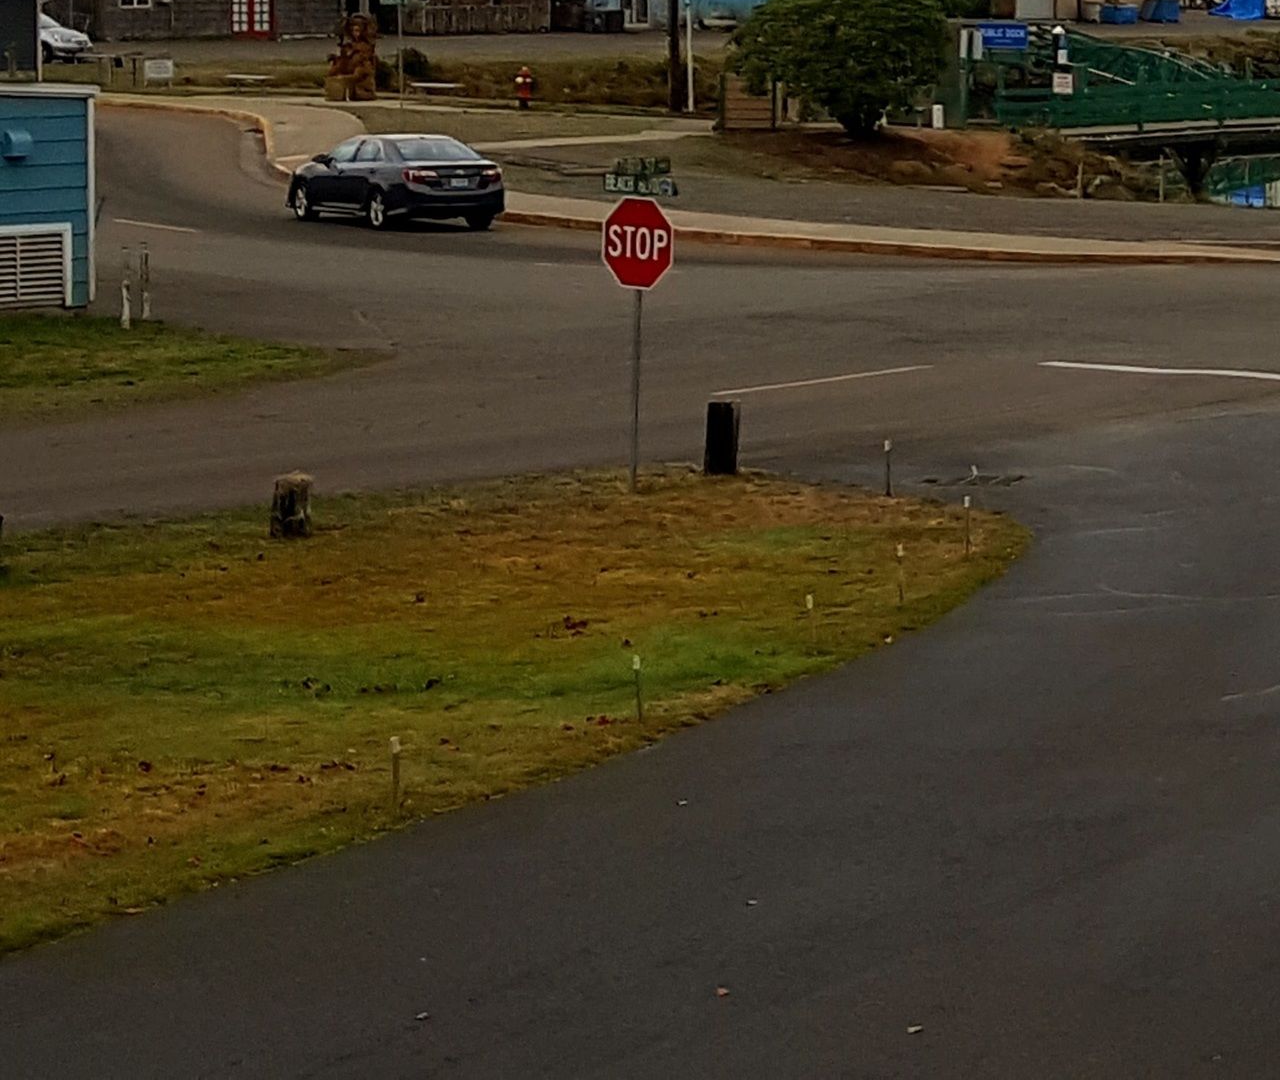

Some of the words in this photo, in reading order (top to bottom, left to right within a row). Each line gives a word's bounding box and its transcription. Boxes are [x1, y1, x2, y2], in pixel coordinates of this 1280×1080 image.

[1005, 28, 1025, 38] DOCK
[605, 174, 634, 191] BEACH
[608, 224, 668, 261] STOP
